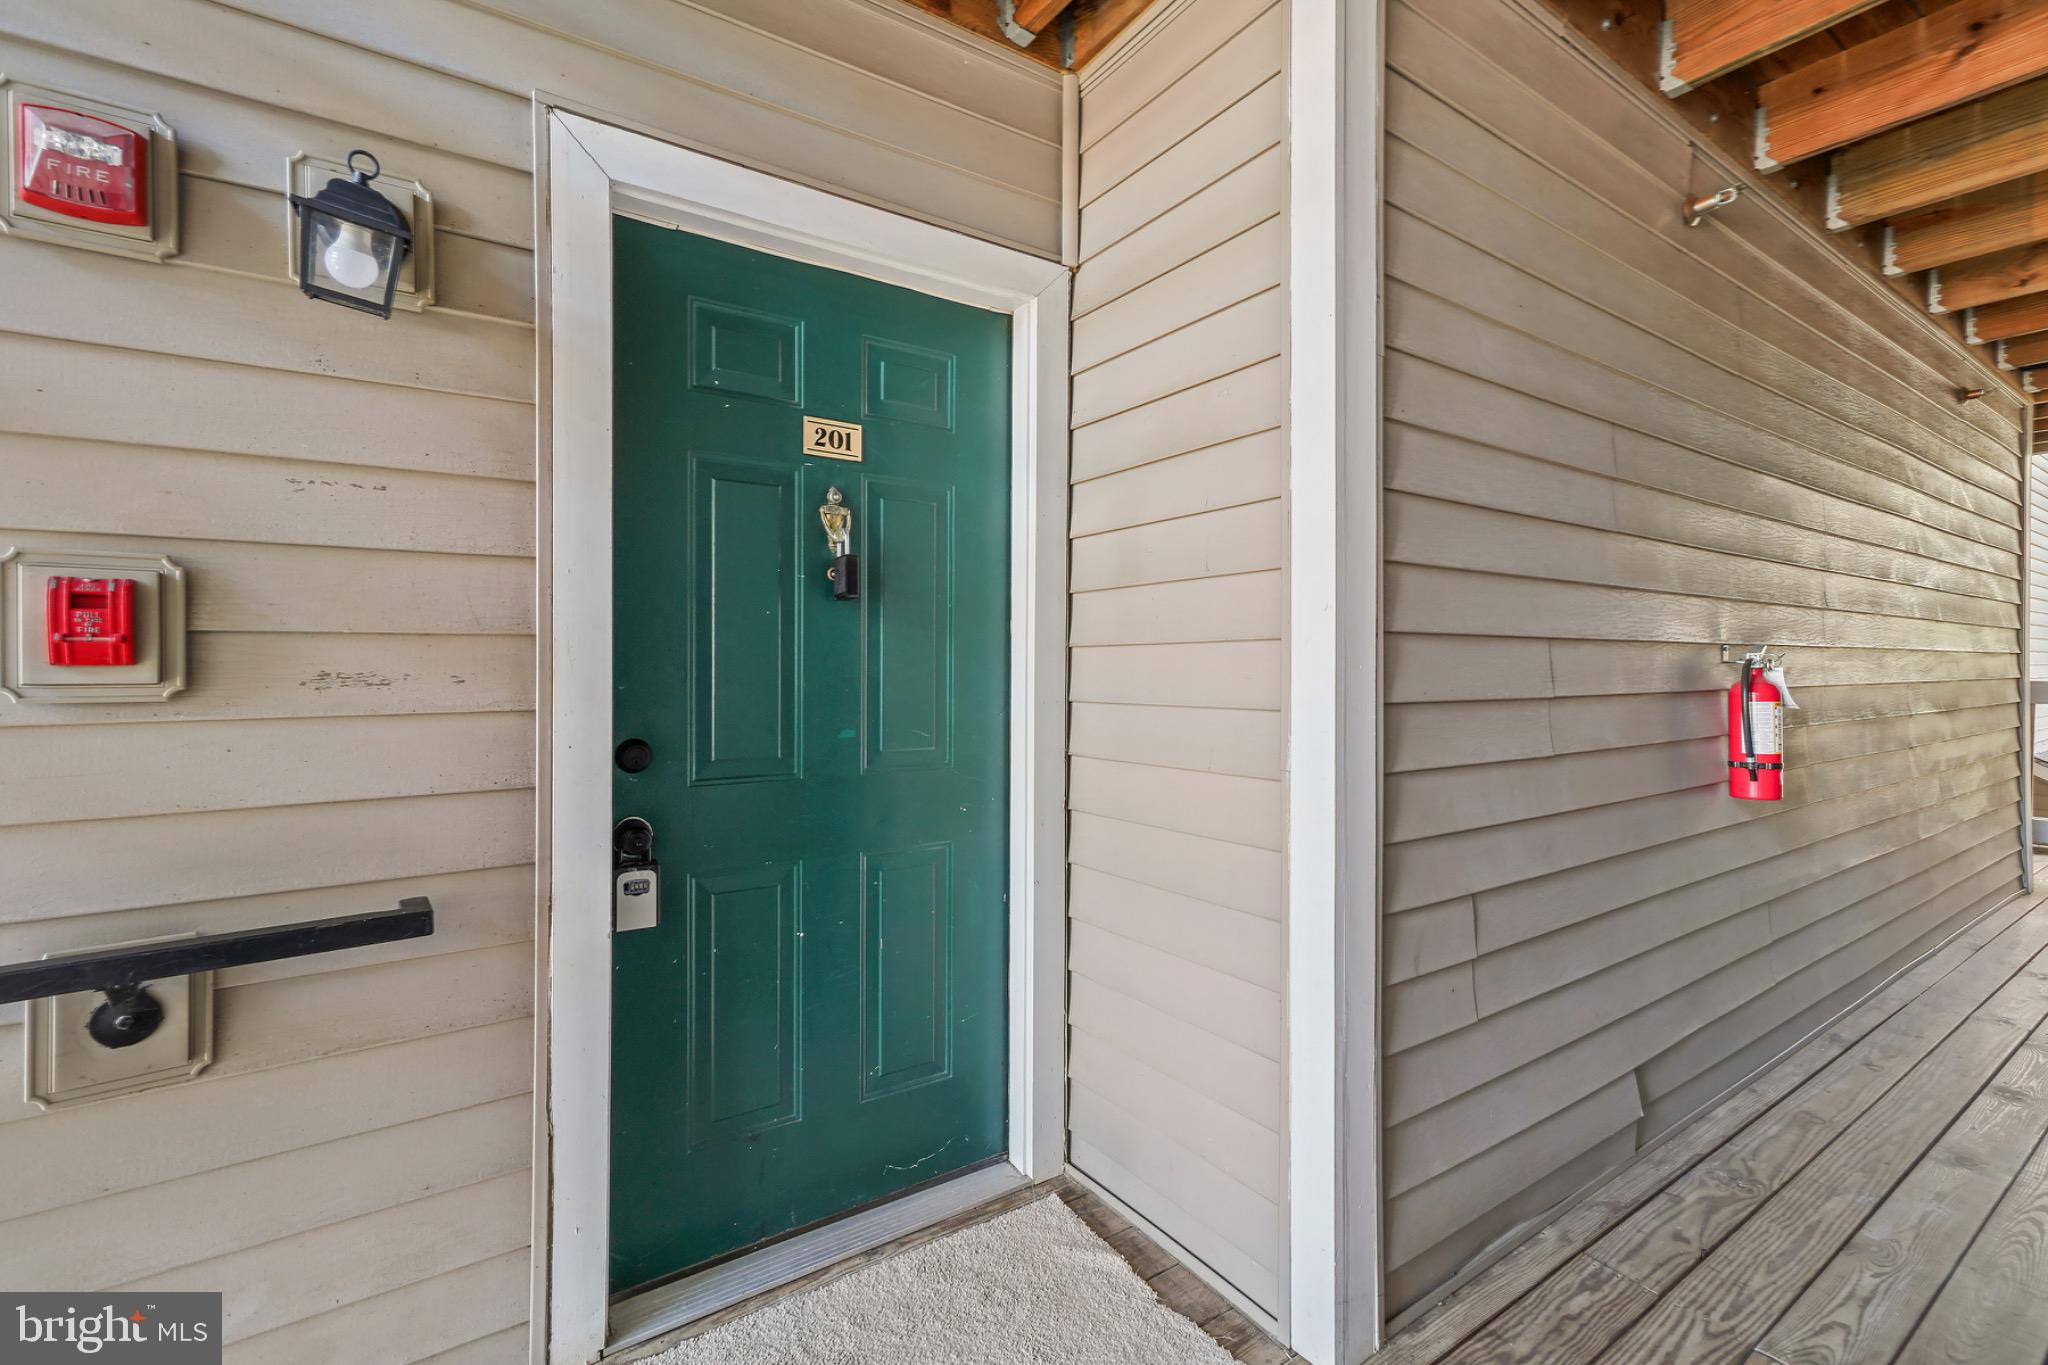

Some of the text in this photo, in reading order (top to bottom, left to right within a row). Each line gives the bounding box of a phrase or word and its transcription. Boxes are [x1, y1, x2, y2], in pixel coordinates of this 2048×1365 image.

[46, 158, 111, 184] FIRE
[814, 427, 852, 452] 201
[76, 626, 102, 634] FIRE
